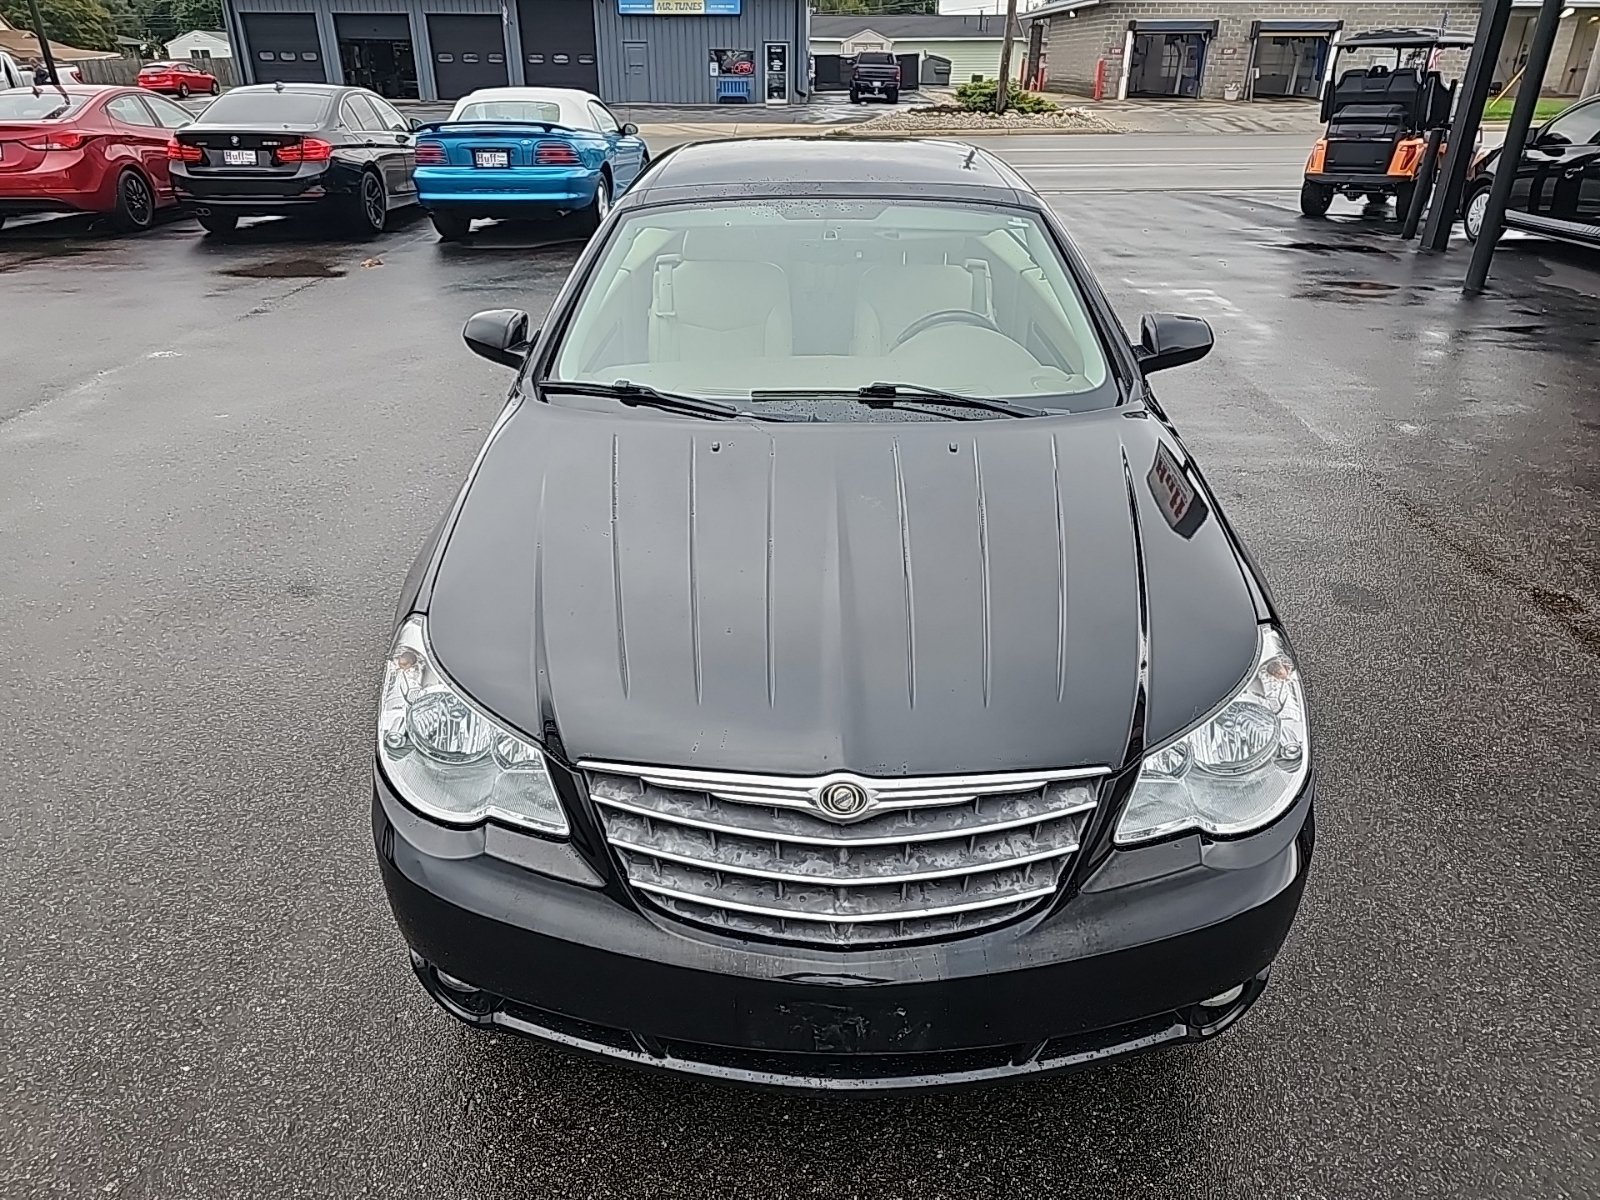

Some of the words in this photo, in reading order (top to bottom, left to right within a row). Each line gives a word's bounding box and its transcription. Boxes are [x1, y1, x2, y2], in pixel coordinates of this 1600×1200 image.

[656, 2, 672, 10] MR.
[674, 2, 702, 10] TUNES
[477, 153, 497, 162] Huff
